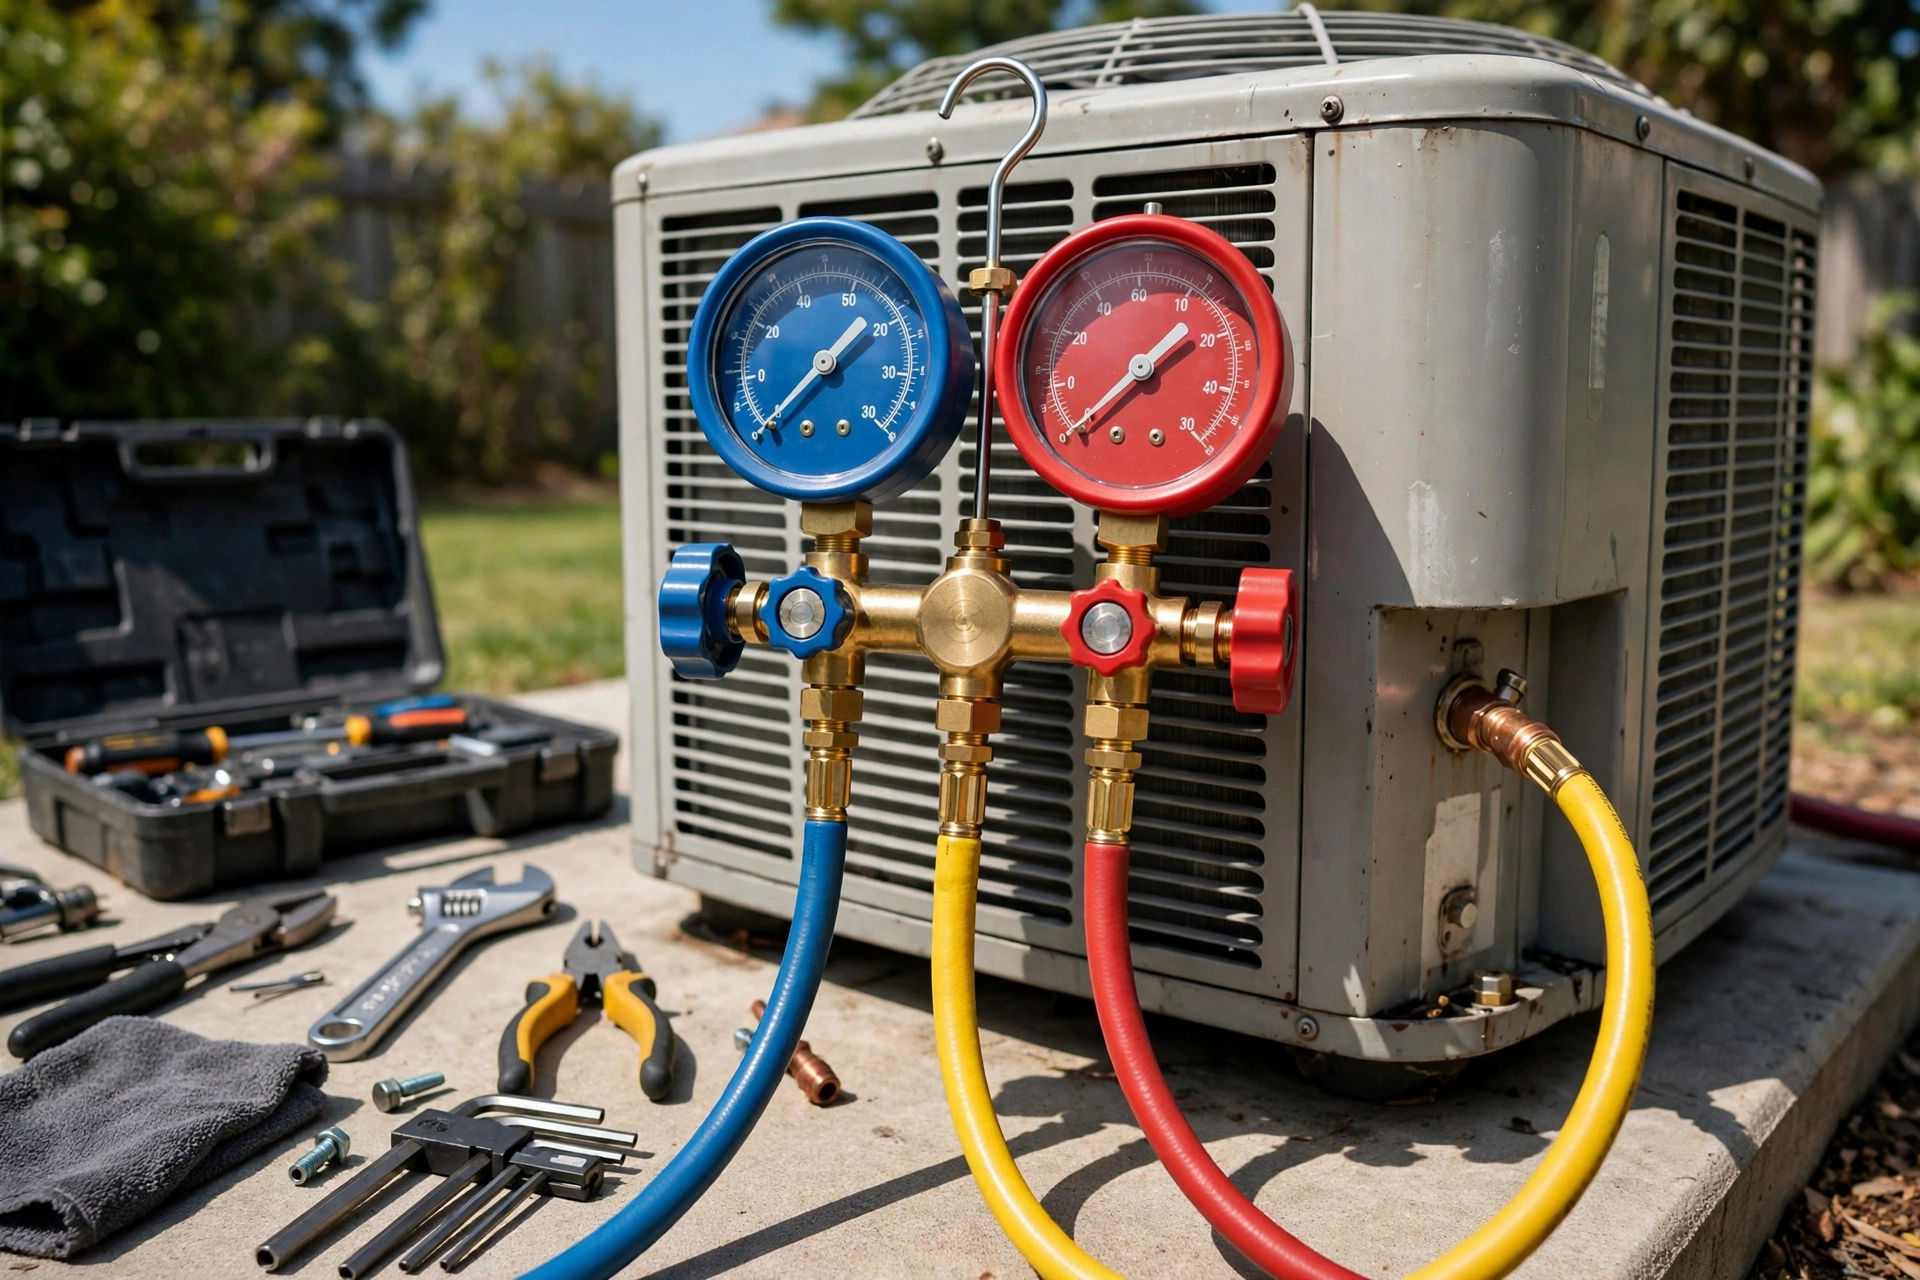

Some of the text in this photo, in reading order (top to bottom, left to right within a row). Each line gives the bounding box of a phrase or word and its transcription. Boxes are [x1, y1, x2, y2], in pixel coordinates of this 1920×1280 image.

[796, 294, 811, 308] 40
[842, 292, 856, 307] 50
[1131, 288, 1147, 302] 60
[1096, 301, 1112, 316] 40
[1174, 298, 1188, 312] 10
[765, 325, 780, 339] 20
[873, 322, 888, 337] 20
[1072, 331, 1087, 345] 20
[1199, 333, 1215, 347] 20
[757, 369, 765, 382] 0
[881, 365, 896, 379] 30
[1067, 375, 1075, 390] 0
[1202, 380, 1218, 395] 40
[861, 405, 876, 419] 30
[1179, 416, 1195, 431] 30
[751, 431, 758, 440] 0
[1059, 433, 1066, 443] 0
